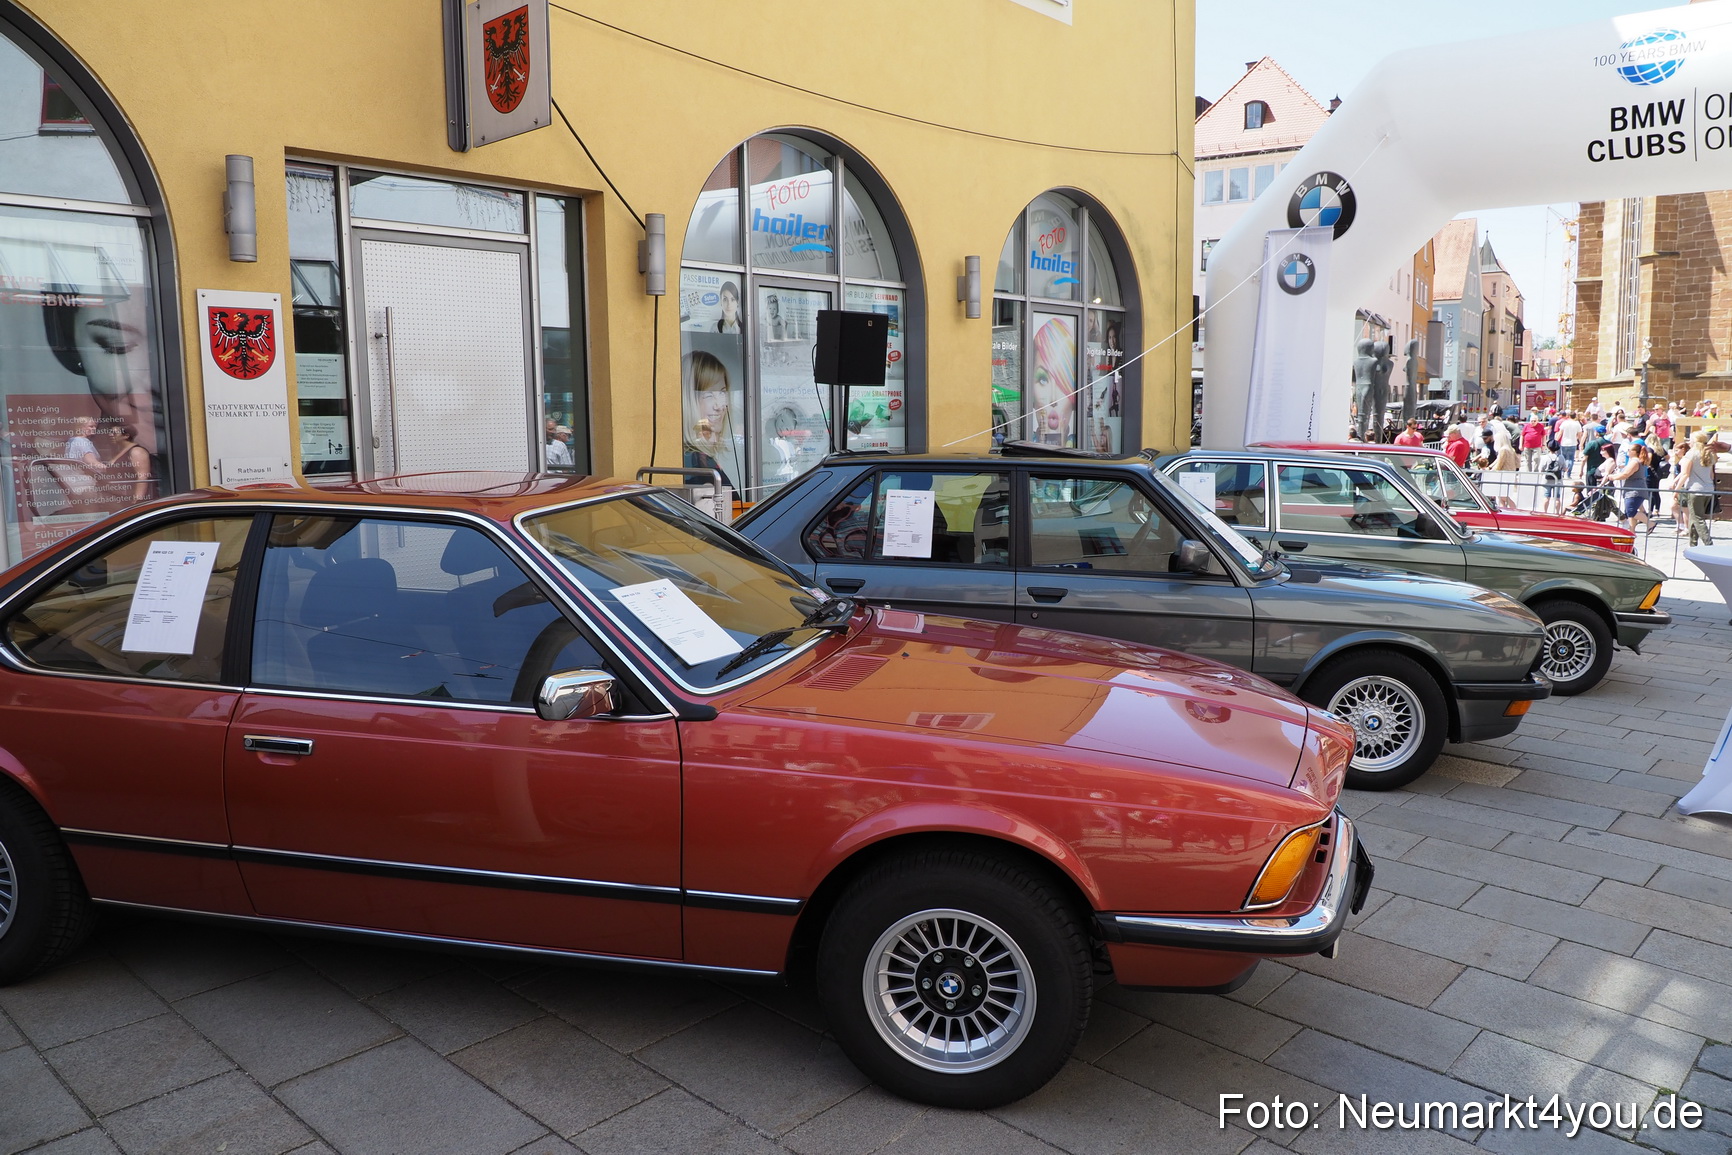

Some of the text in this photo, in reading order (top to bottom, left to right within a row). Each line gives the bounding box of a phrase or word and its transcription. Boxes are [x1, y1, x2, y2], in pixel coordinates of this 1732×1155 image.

[1593, 40, 1706, 67] 100 YEARS BMW
[1705, 91, 1732, 120] O
[1610, 98, 1686, 132] BMW
[1705, 125, 1732, 150] O
[1587, 131, 1686, 162] CLUBS
[1295, 173, 1350, 198] BMW
[766, 179, 810, 210] FOTO
[752, 207, 829, 240] hailer
[1038, 227, 1066, 255] FOTO
[1030, 250, 1079, 275] hailer
[1280, 254, 1312, 268] BMW
[683, 273, 720, 285] PASSBILDER
[781, 296, 797, 305] Mein
[1106, 348, 1123, 357] Bilder
[35, 405, 60, 414] Aging
[207, 403, 287, 411] STADTVERWALTUNG
[17, 416, 125, 426] Lebendig frisches Aussehen
[19, 427, 126, 437] Verbesserung der Elastizität
[23, 475, 77, 485] Verfeinerung
[93, 473, 116, 481] Falten
[24, 487, 70, 496] Entfernung
[88, 484, 132, 492] Hautflecken
[26, 499, 66, 508] Reparatur
[84, 496, 132, 506] geschädigter
[34, 530, 64, 539] Fühle
